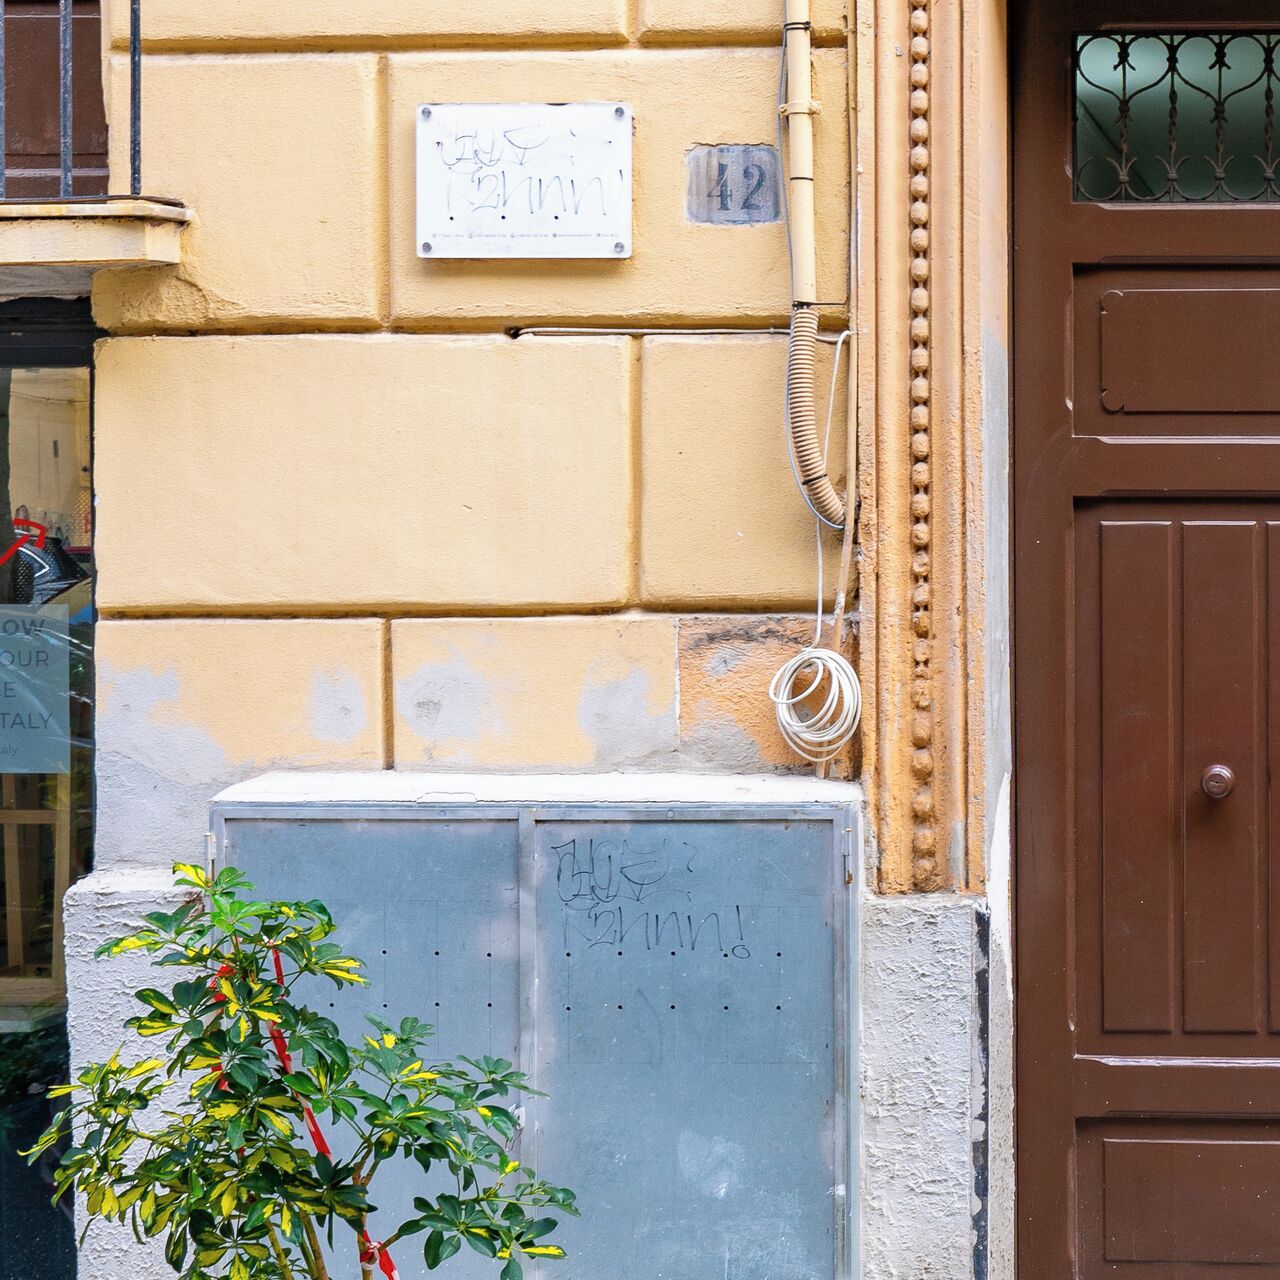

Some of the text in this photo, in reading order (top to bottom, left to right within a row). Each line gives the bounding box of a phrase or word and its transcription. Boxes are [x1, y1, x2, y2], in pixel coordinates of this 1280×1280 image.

[706, 162, 767, 211] 42
[0, 650, 49, 667] OUR
[0, 681, 17, 698] E
[0, 712, 54, 729] TALY
[0, 744, 18, 757] aly
